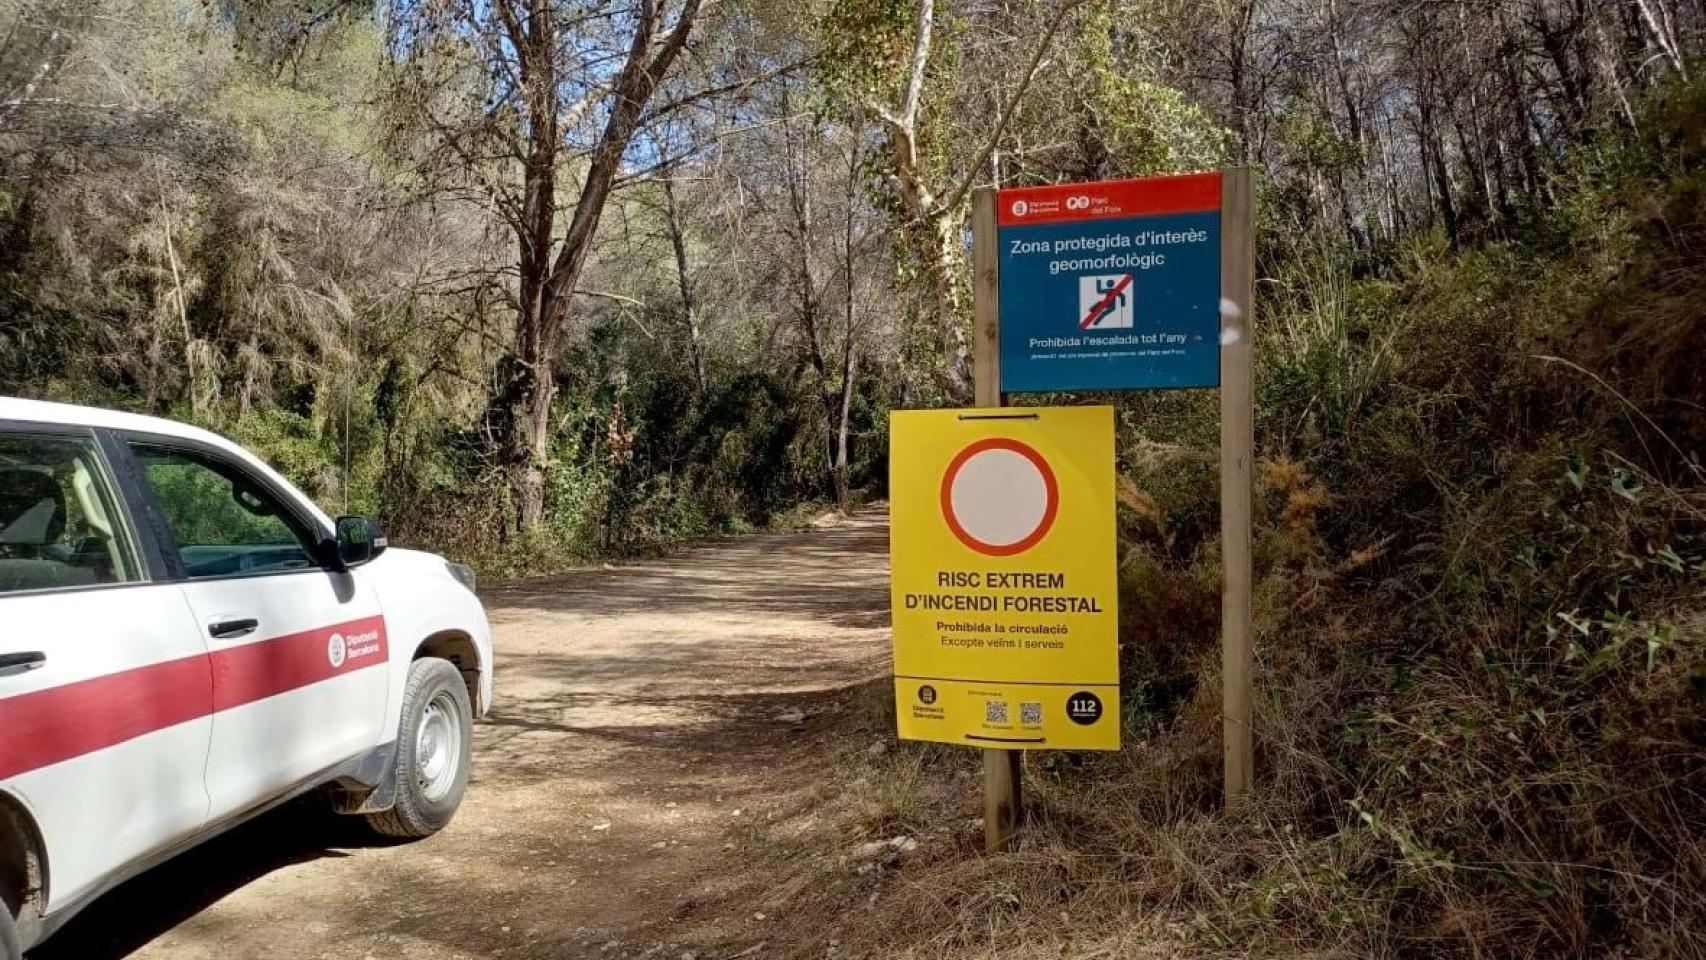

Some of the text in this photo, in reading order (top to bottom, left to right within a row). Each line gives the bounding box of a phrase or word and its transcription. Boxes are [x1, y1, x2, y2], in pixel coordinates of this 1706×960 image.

[1010, 228, 1208, 255] Zona protegida d'interès
[1049, 252, 1166, 275] geomorfològic
[1029, 332, 1187, 348] Prohibida l'escalada tot l'any
[938, 571, 1065, 589] RISC EXTREM
[905, 594, 1103, 613] D'INCENDI FORESTAL
[936, 621, 1069, 635] Prohibida la circulació
[941, 636, 985, 648] Excepte
[987, 637, 1015, 648] veïns
[1025, 639, 1064, 649] serveis
[1072, 699, 1096, 713] 112
